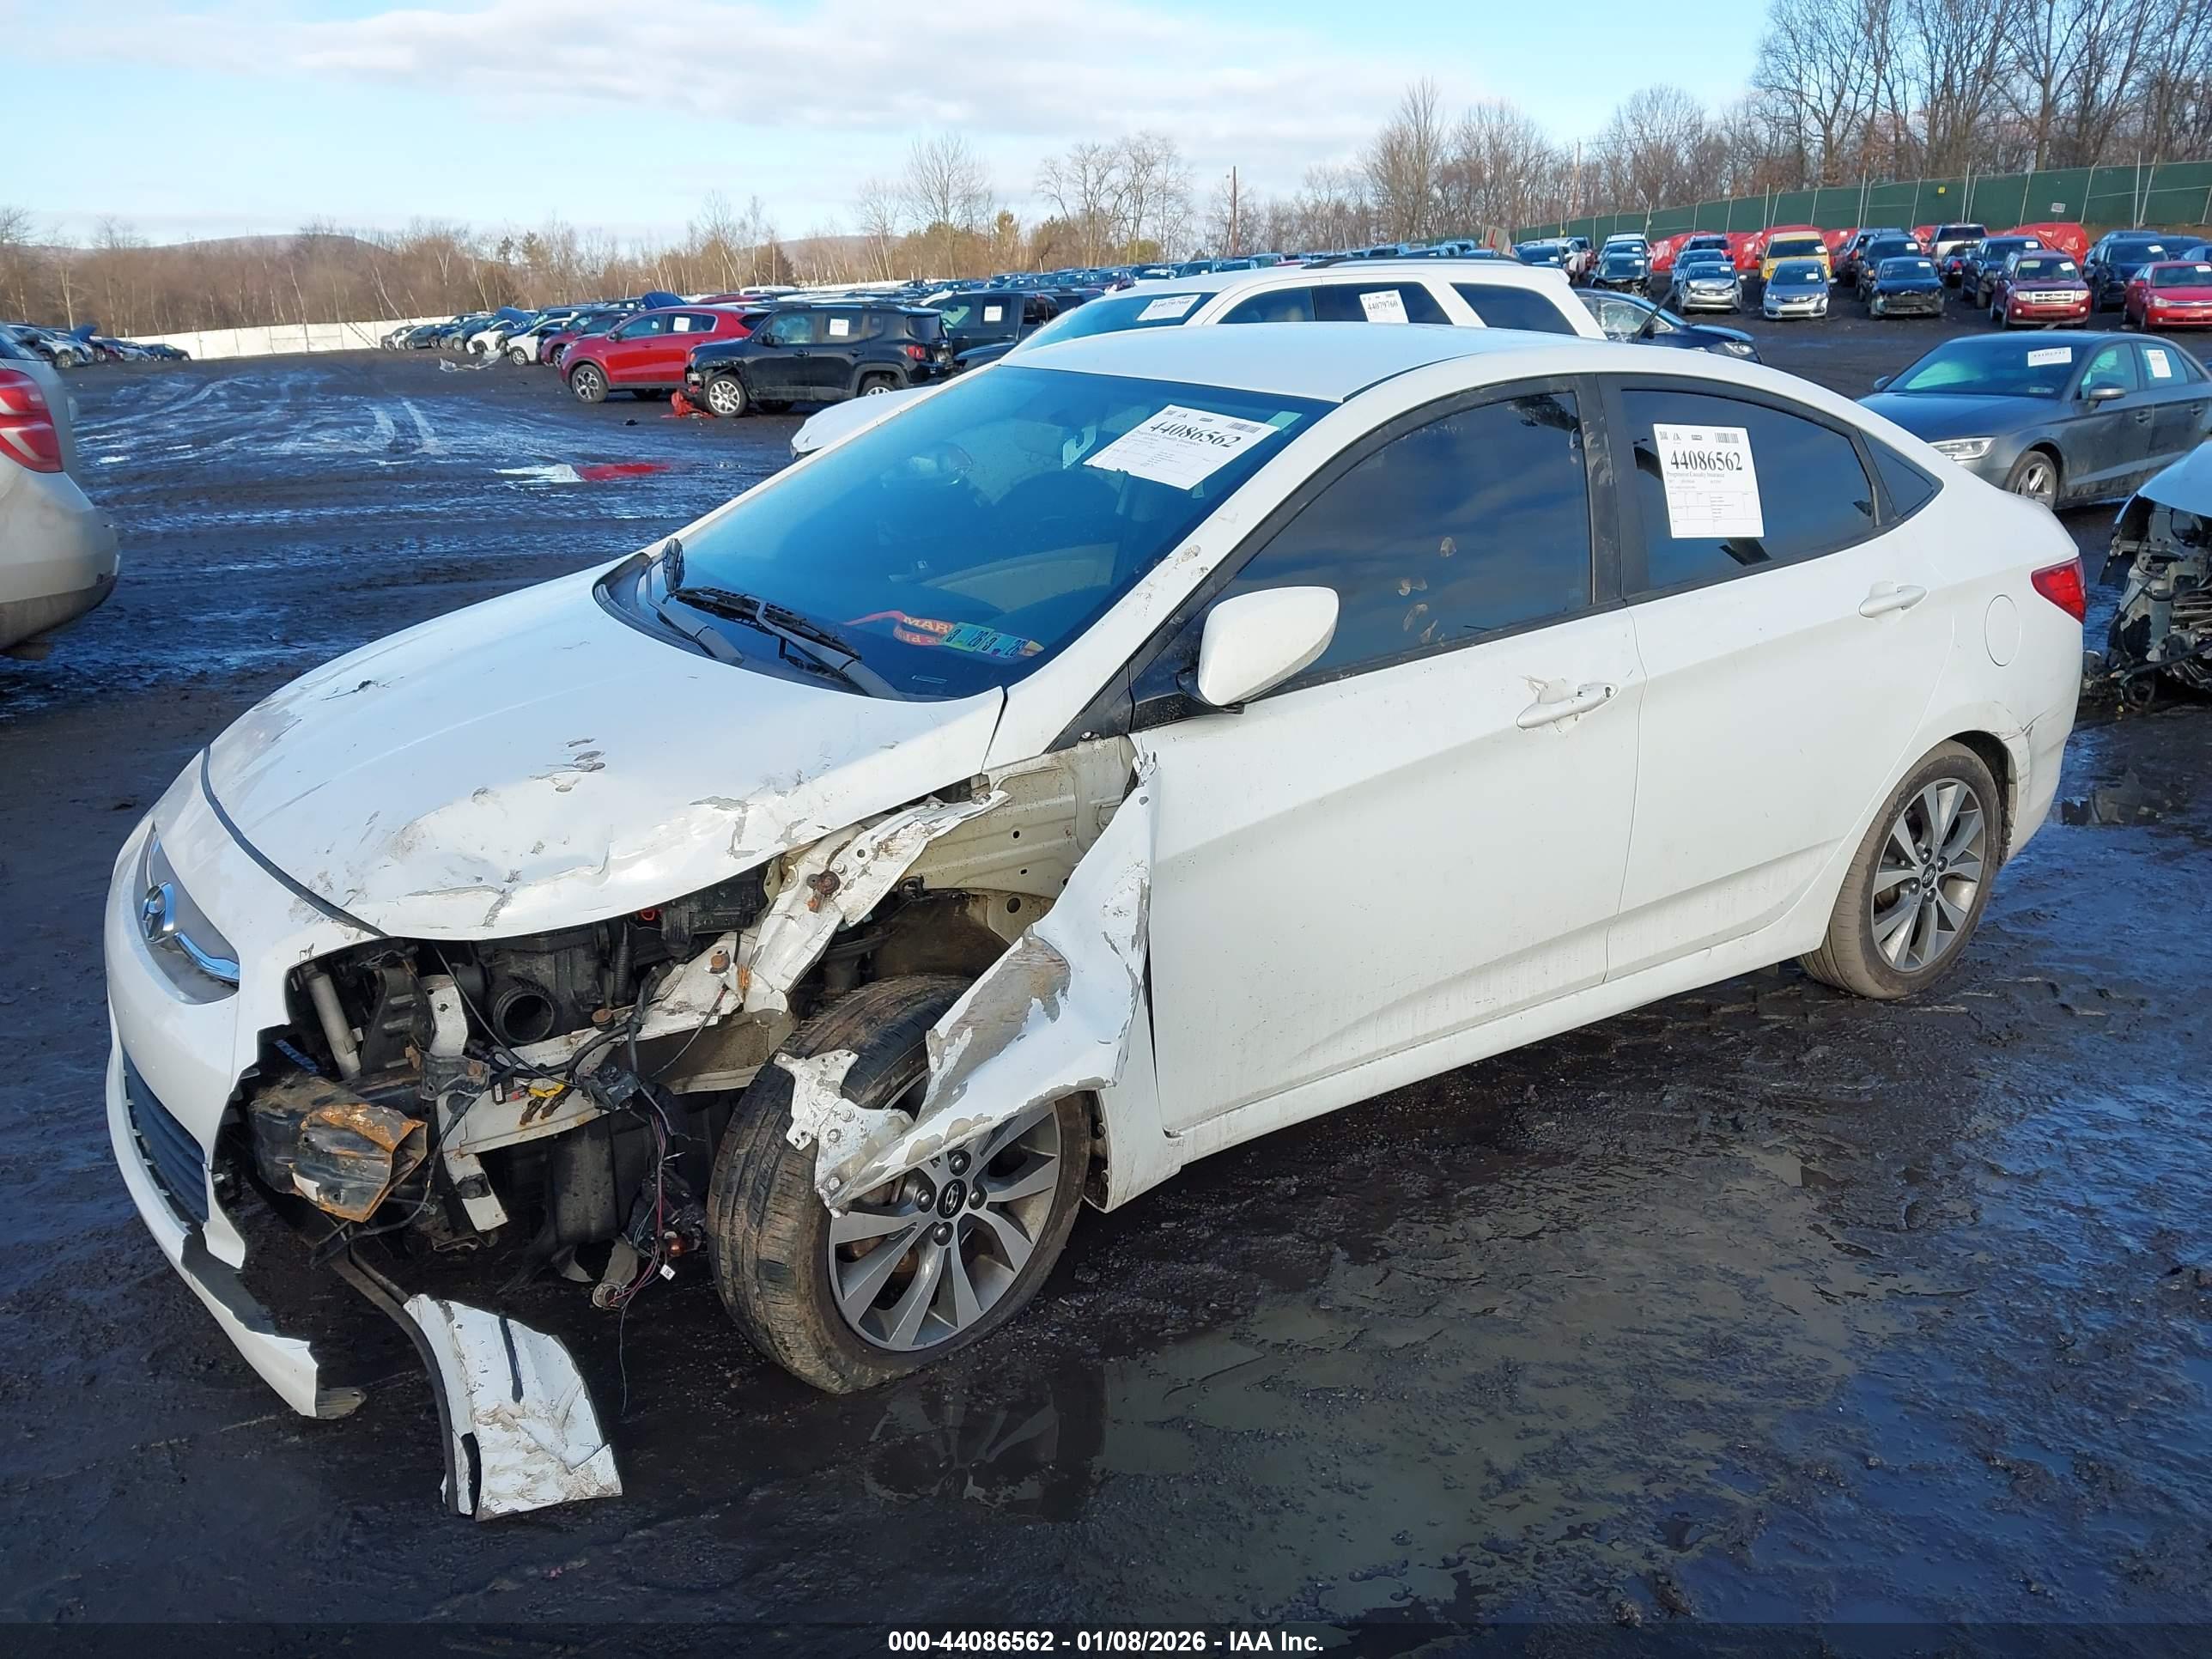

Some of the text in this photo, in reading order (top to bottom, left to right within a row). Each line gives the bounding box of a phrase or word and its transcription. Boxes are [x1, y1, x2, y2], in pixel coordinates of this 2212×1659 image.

[1150, 421, 1243, 447] 44086562
[1670, 449, 1743, 471] 44086562
[903, 617, 952, 635] MAR
[945, 629, 963, 642] 3
[981, 637, 998, 652] 3
